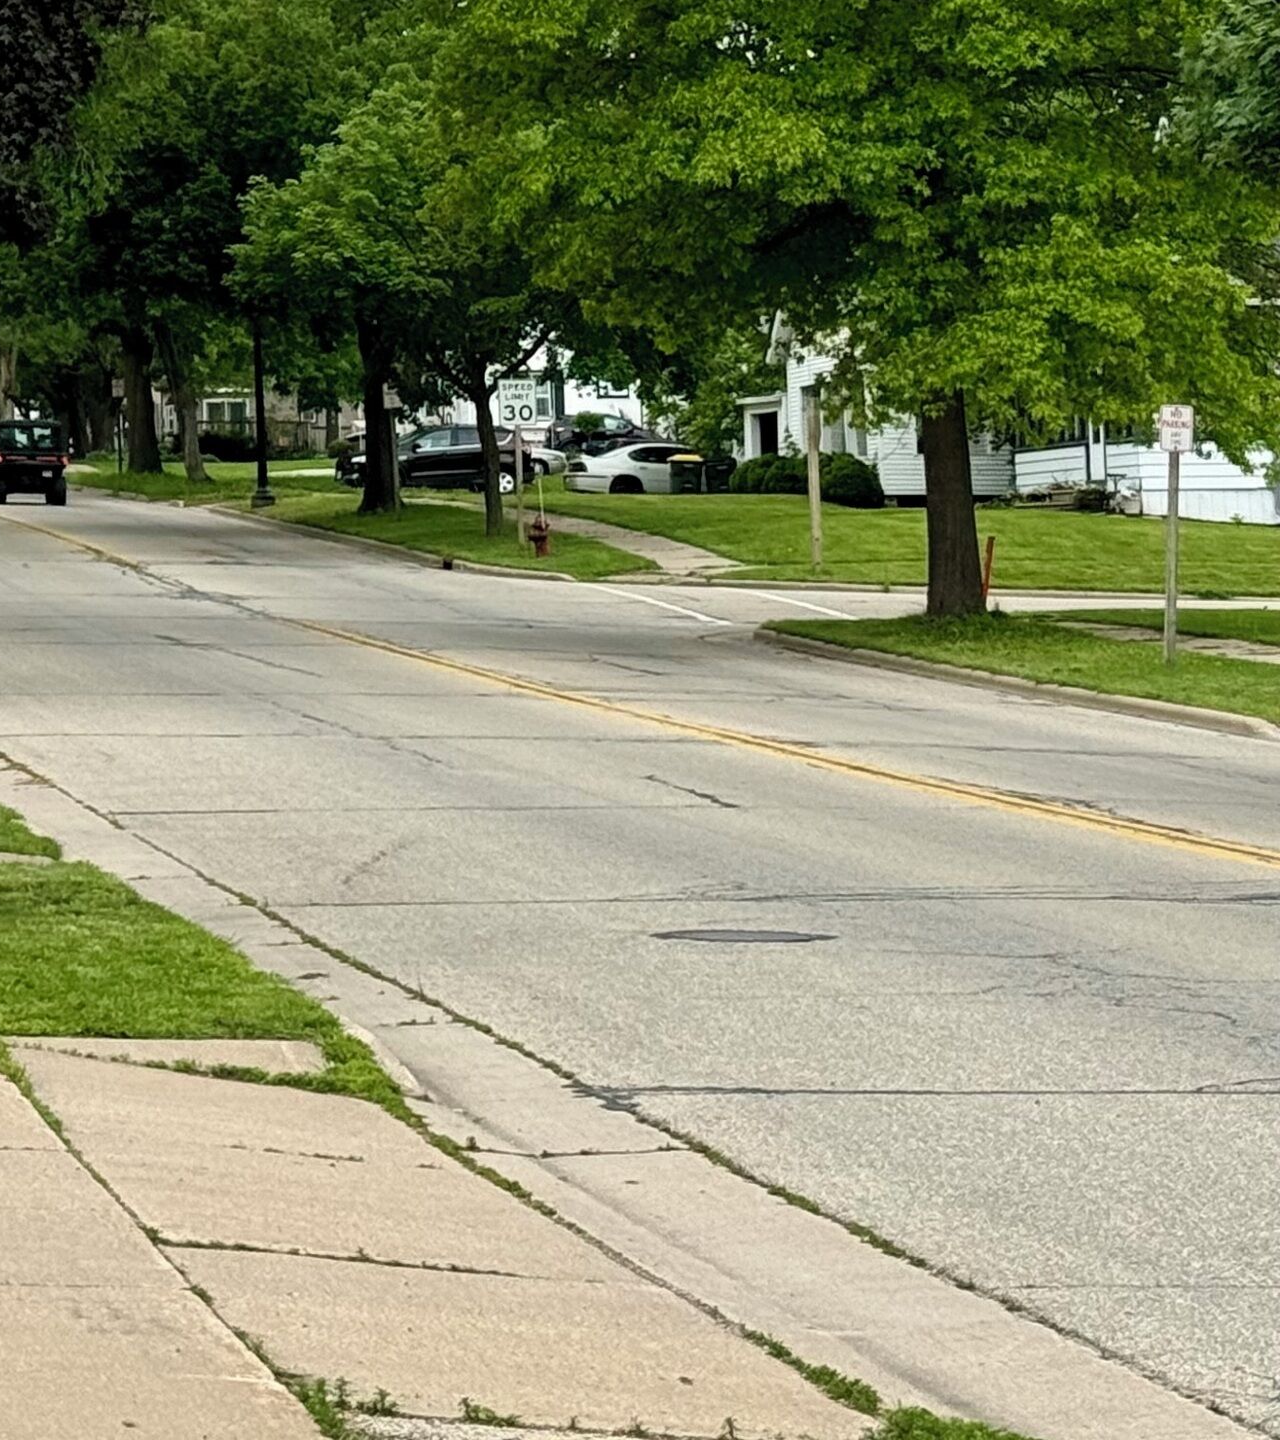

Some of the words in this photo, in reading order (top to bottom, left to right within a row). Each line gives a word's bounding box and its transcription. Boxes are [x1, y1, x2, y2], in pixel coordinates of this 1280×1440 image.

[502, 383, 533, 391] SPEED
[504, 393, 530, 401] LIMIT
[503, 405, 533, 421] 30
[1170, 409, 1183, 419] NO
[1160, 420, 1191, 429] PARKING
